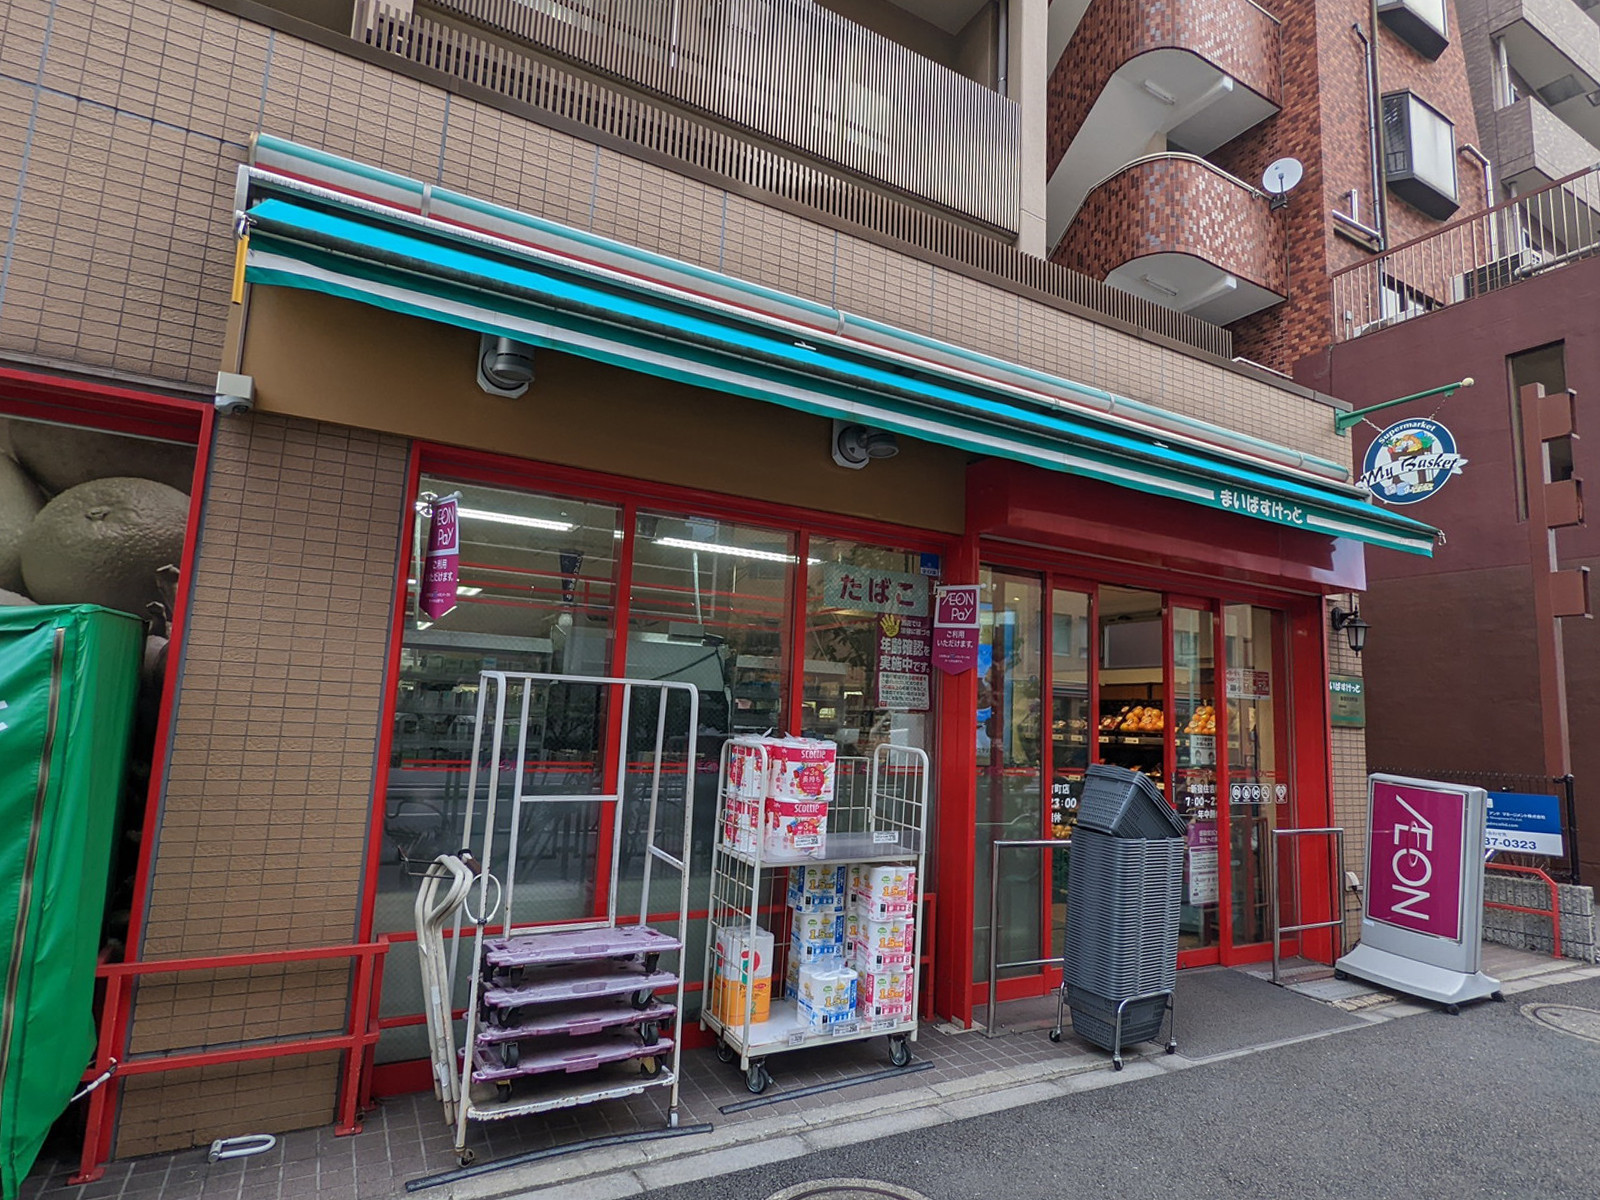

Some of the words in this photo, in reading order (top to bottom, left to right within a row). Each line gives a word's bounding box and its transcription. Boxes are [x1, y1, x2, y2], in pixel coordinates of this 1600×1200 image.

[1378, 420, 1436, 445] Supermarket
[1361, 465, 1394, 488] My
[1401, 453, 1458, 472] Basket
[1219, 489, 1304, 524] まいばすけっと
[840, 574, 915, 607] たばこ
[951, 607, 974, 621] Pay
[946, 630, 966, 639] ご利用
[880, 636, 930, 656] 年齢確認を
[936, 640, 974, 649] いただけます。
[880, 655, 930, 673] 実施中です。
[1051, 784, 1070, 794] 町店
[1051, 812, 1062, 823] 休
[1391, 794, 1433, 921] AEON
